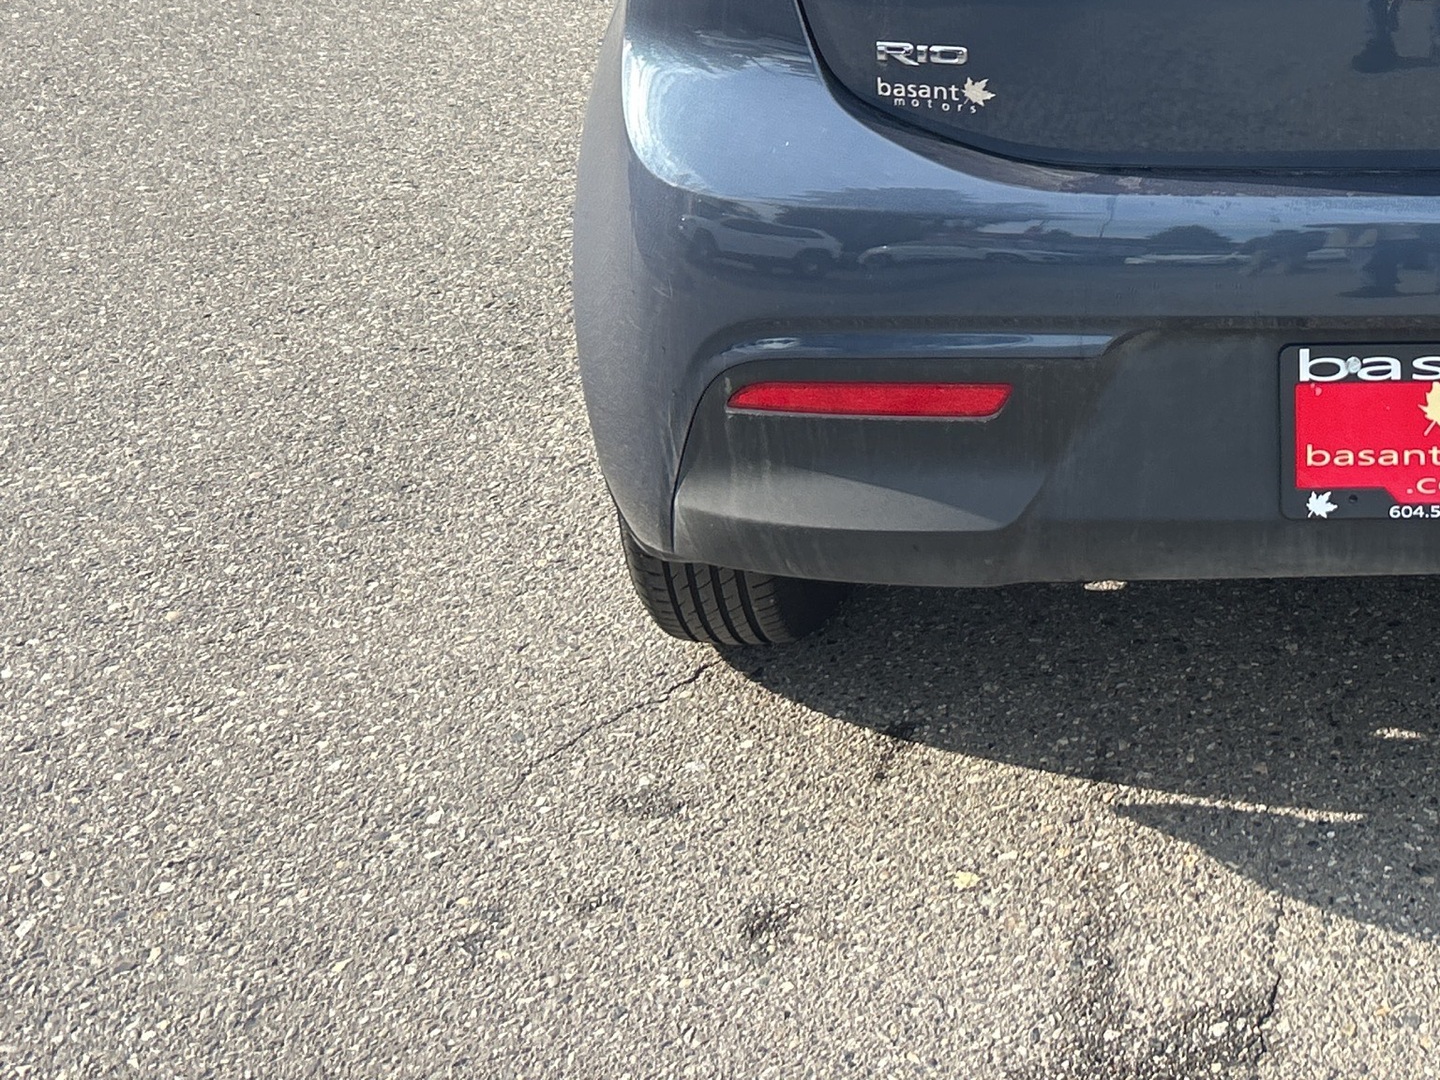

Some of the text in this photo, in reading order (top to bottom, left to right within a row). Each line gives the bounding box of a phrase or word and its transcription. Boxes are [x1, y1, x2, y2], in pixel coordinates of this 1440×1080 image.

[876, 41, 968, 66] RIO
[877, 77, 960, 101] basant
[894, 98, 977, 114] motors
